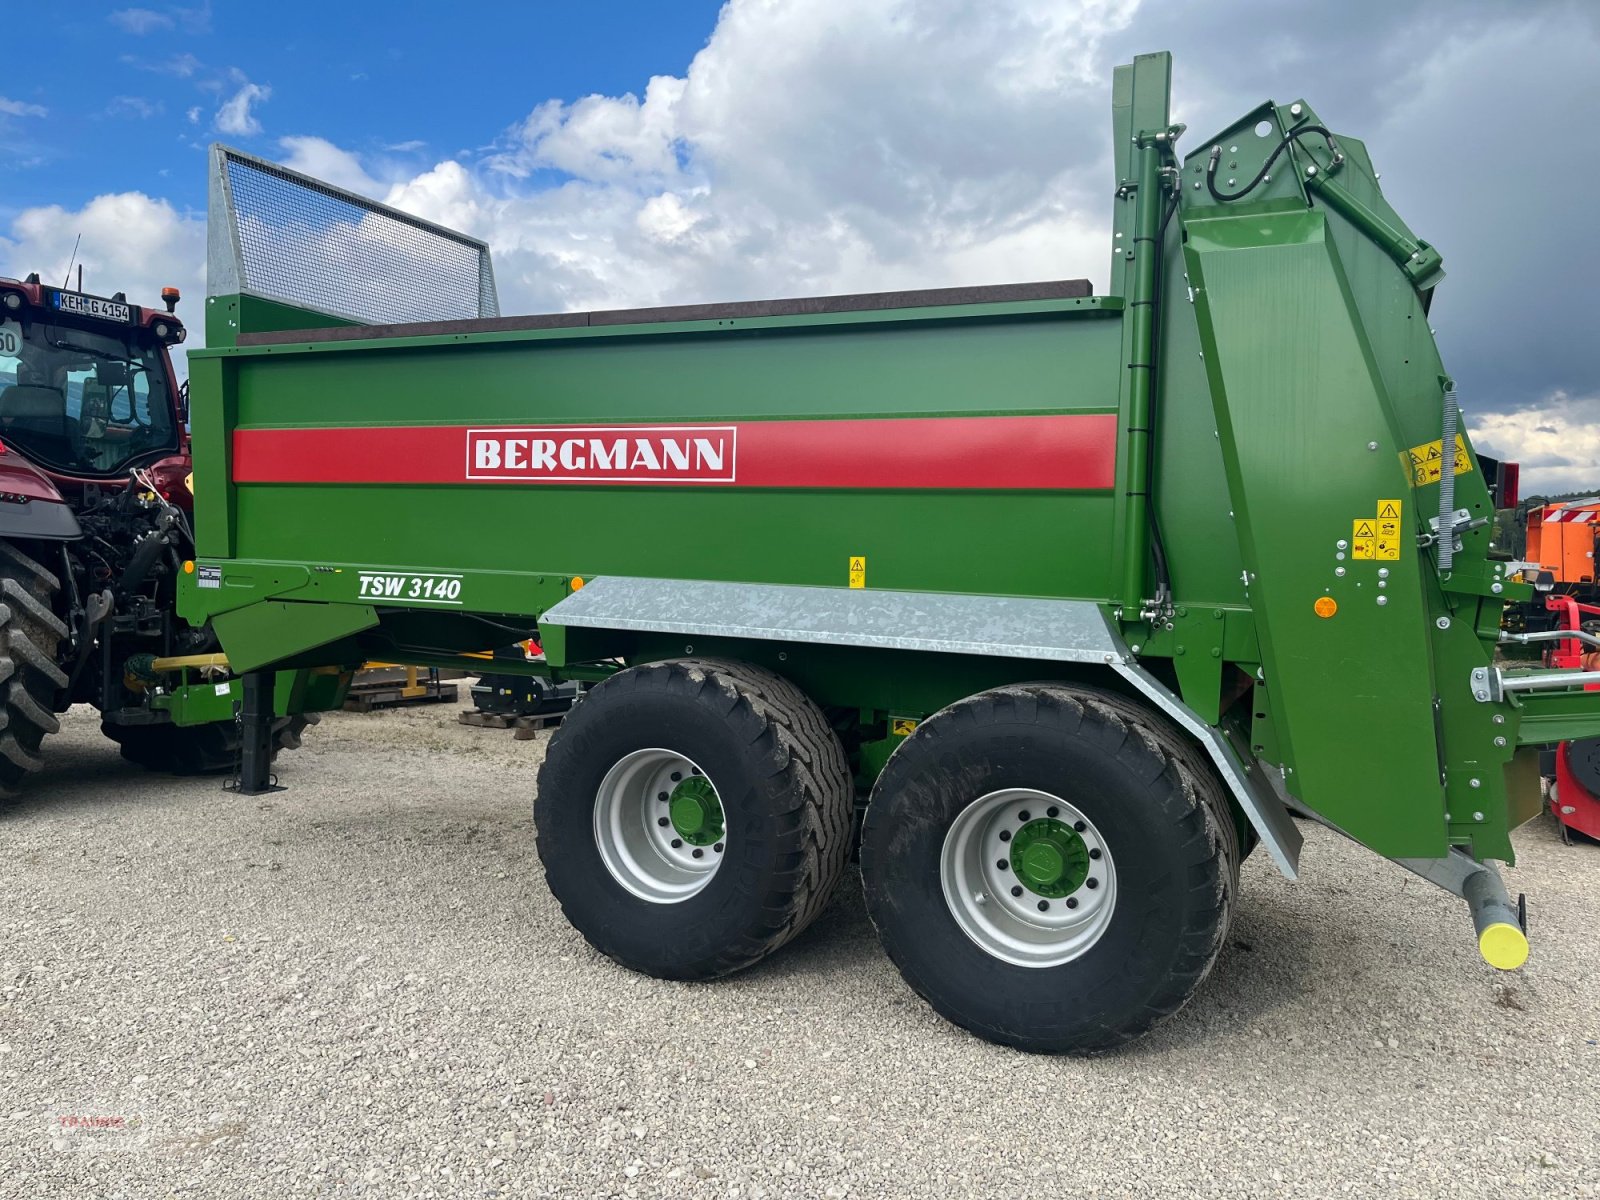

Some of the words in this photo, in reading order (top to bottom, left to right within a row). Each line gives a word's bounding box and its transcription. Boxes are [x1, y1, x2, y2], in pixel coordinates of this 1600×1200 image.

[61, 294, 83, 311] KEH
[91, 300, 99, 313] G
[102, 302, 128, 319] 4154
[476, 438, 724, 471] BERGMANN
[359, 576, 404, 597] TSW
[408, 578, 461, 600] 3140
